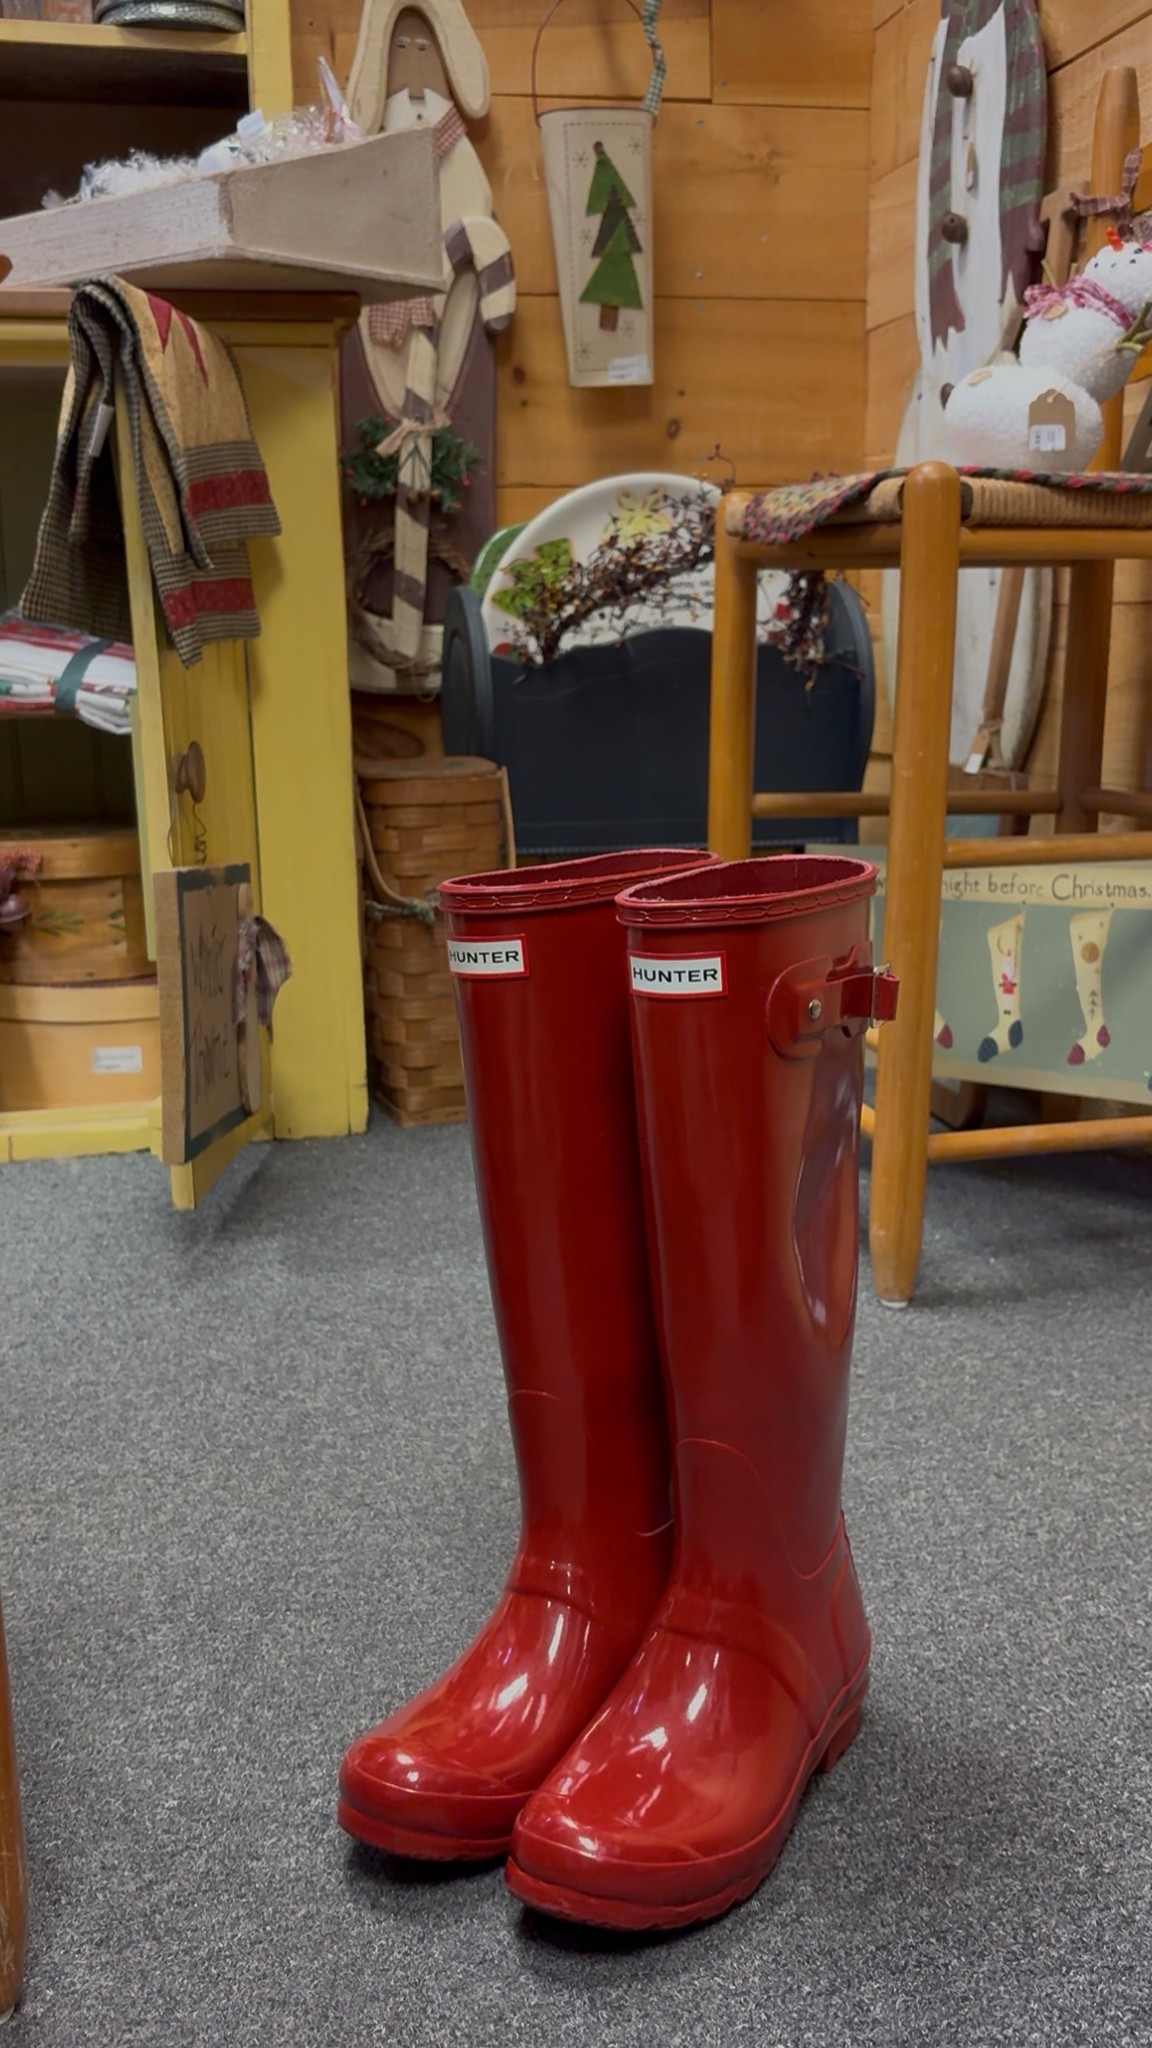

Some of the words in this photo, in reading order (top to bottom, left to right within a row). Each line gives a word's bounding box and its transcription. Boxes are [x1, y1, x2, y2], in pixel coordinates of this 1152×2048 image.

[987, 872, 1045, 897] before
[1051, 873, 1151, 901] Christmas.
[450, 950, 519, 964] HUNTER
[633, 966, 718, 983] HUNTER
